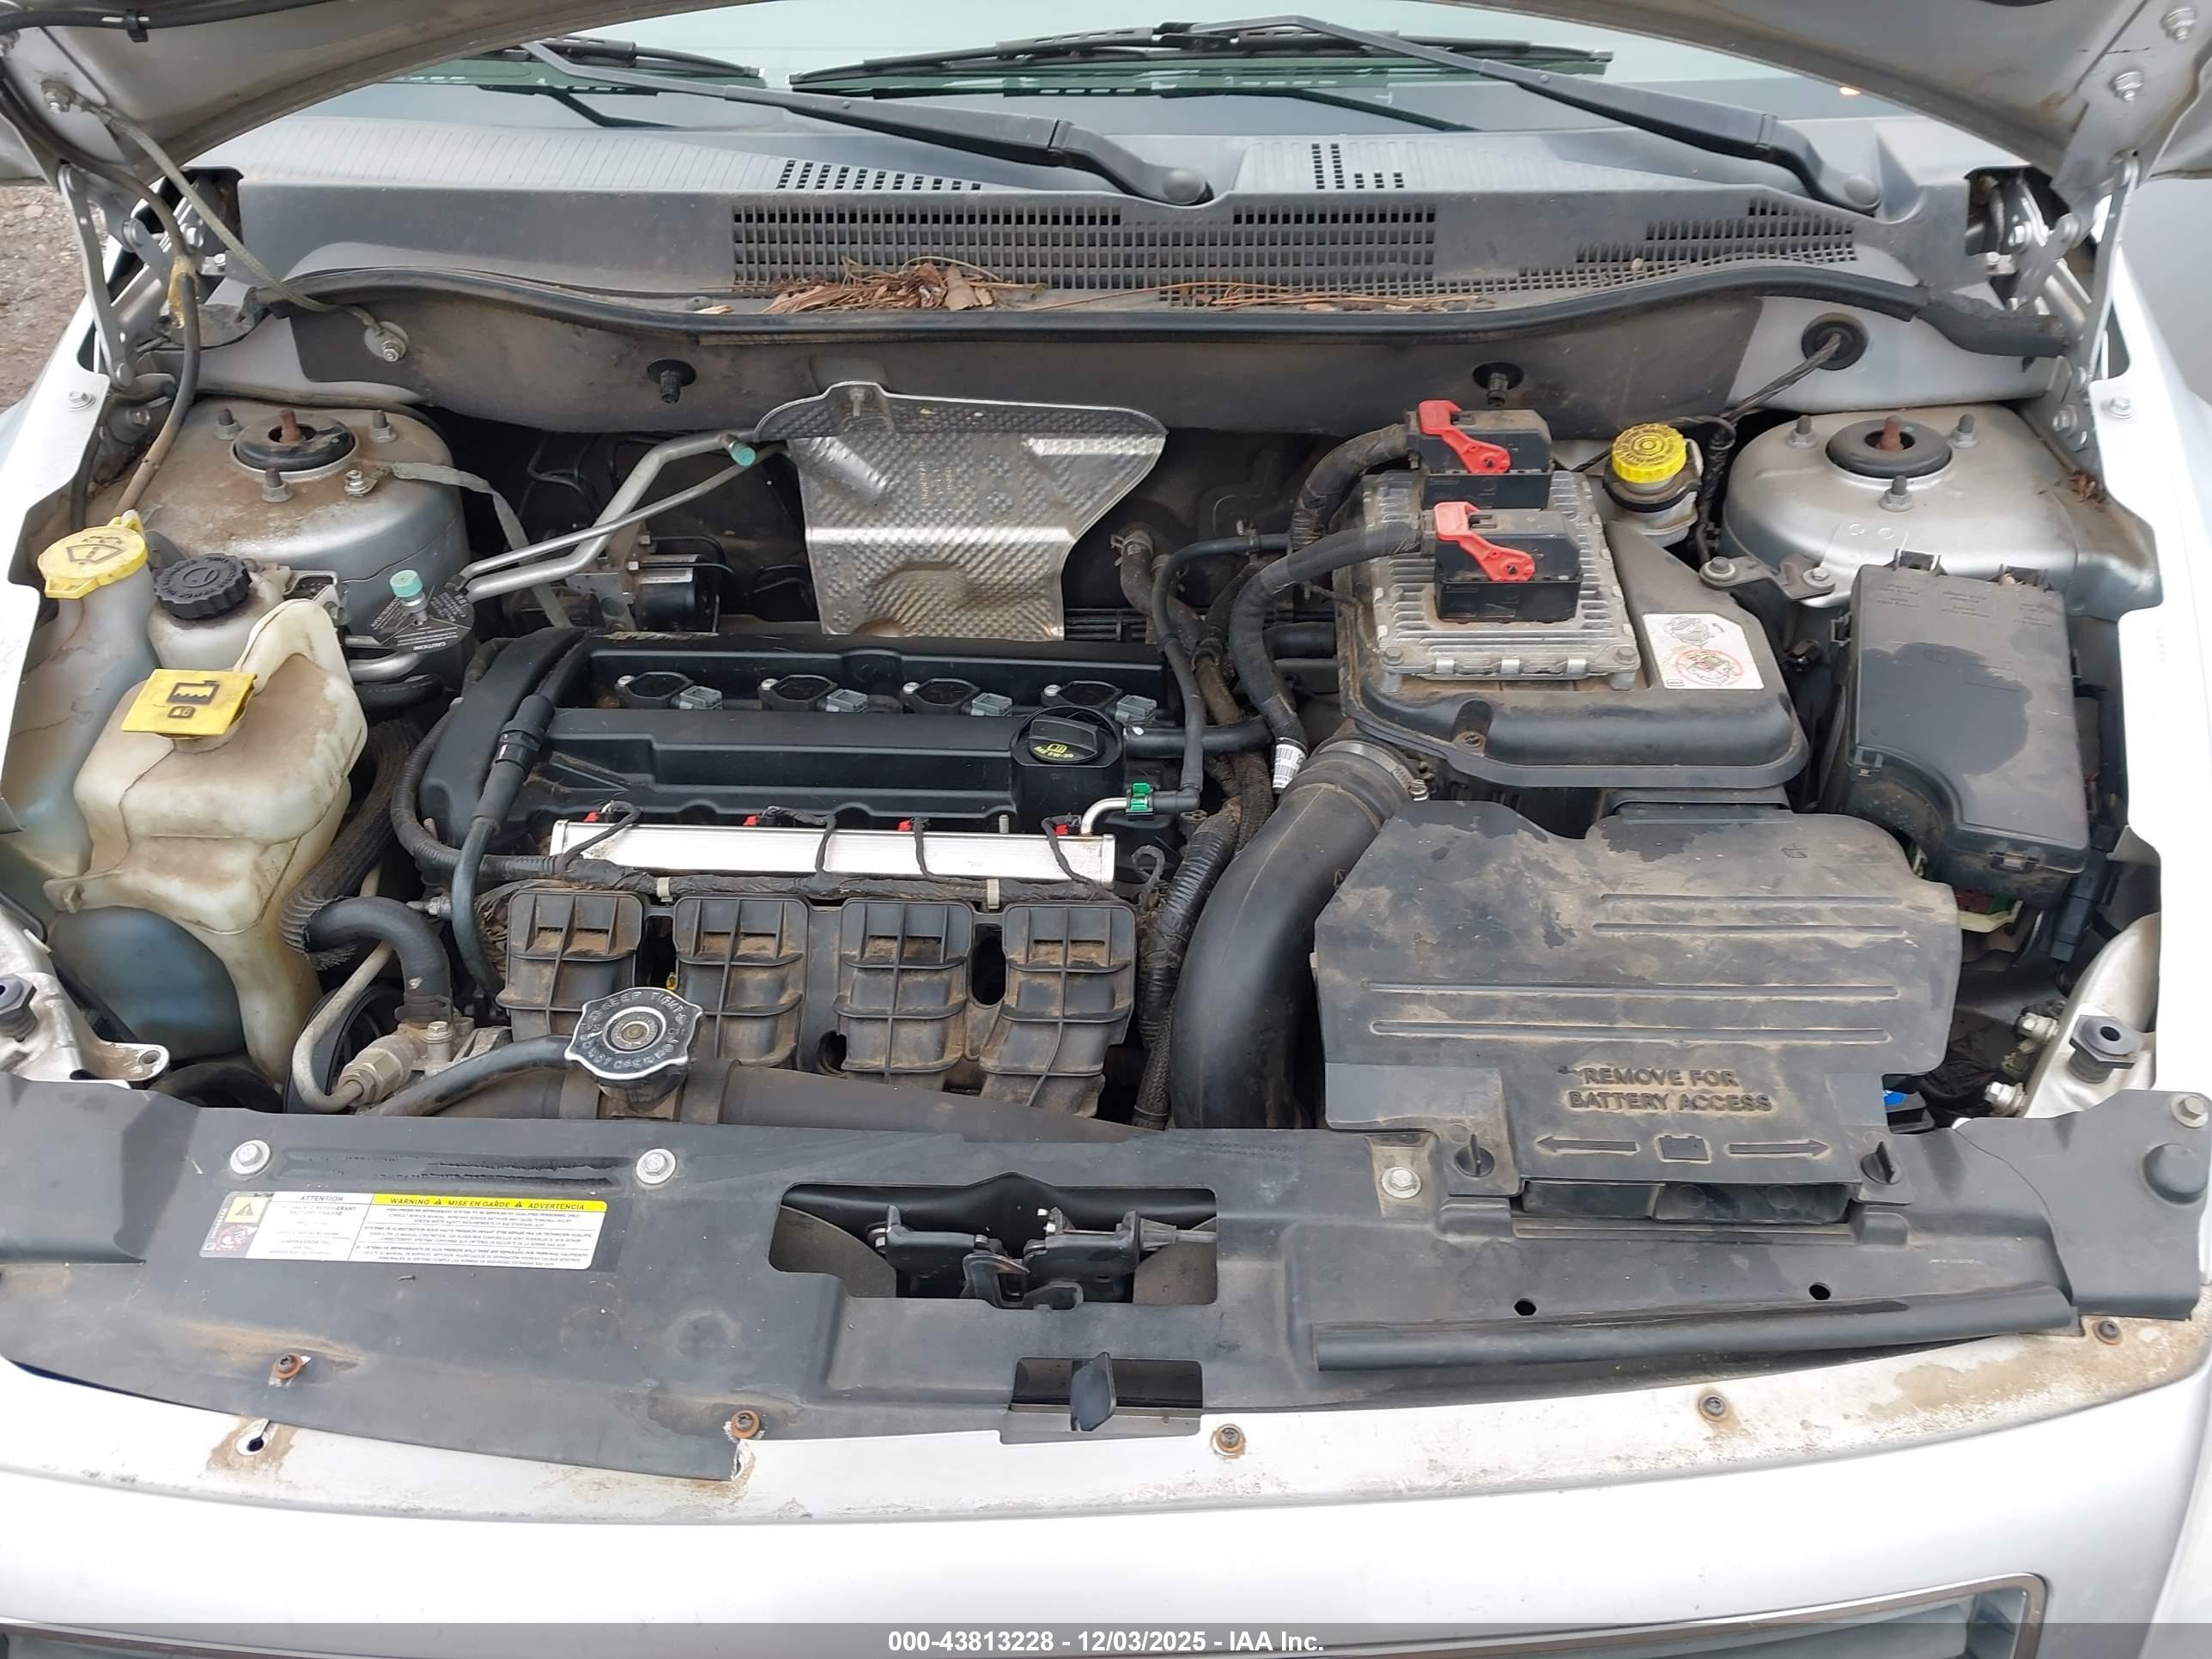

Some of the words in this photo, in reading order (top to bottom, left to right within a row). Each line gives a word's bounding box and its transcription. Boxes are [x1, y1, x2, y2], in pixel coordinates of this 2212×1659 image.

[1583, 1066, 1685, 1087] REMOVE
[1689, 1069, 1739, 1088] FOR
[1567, 1091, 1669, 1111] BATTERY
[1678, 1091, 1774, 1113] ACCESS
